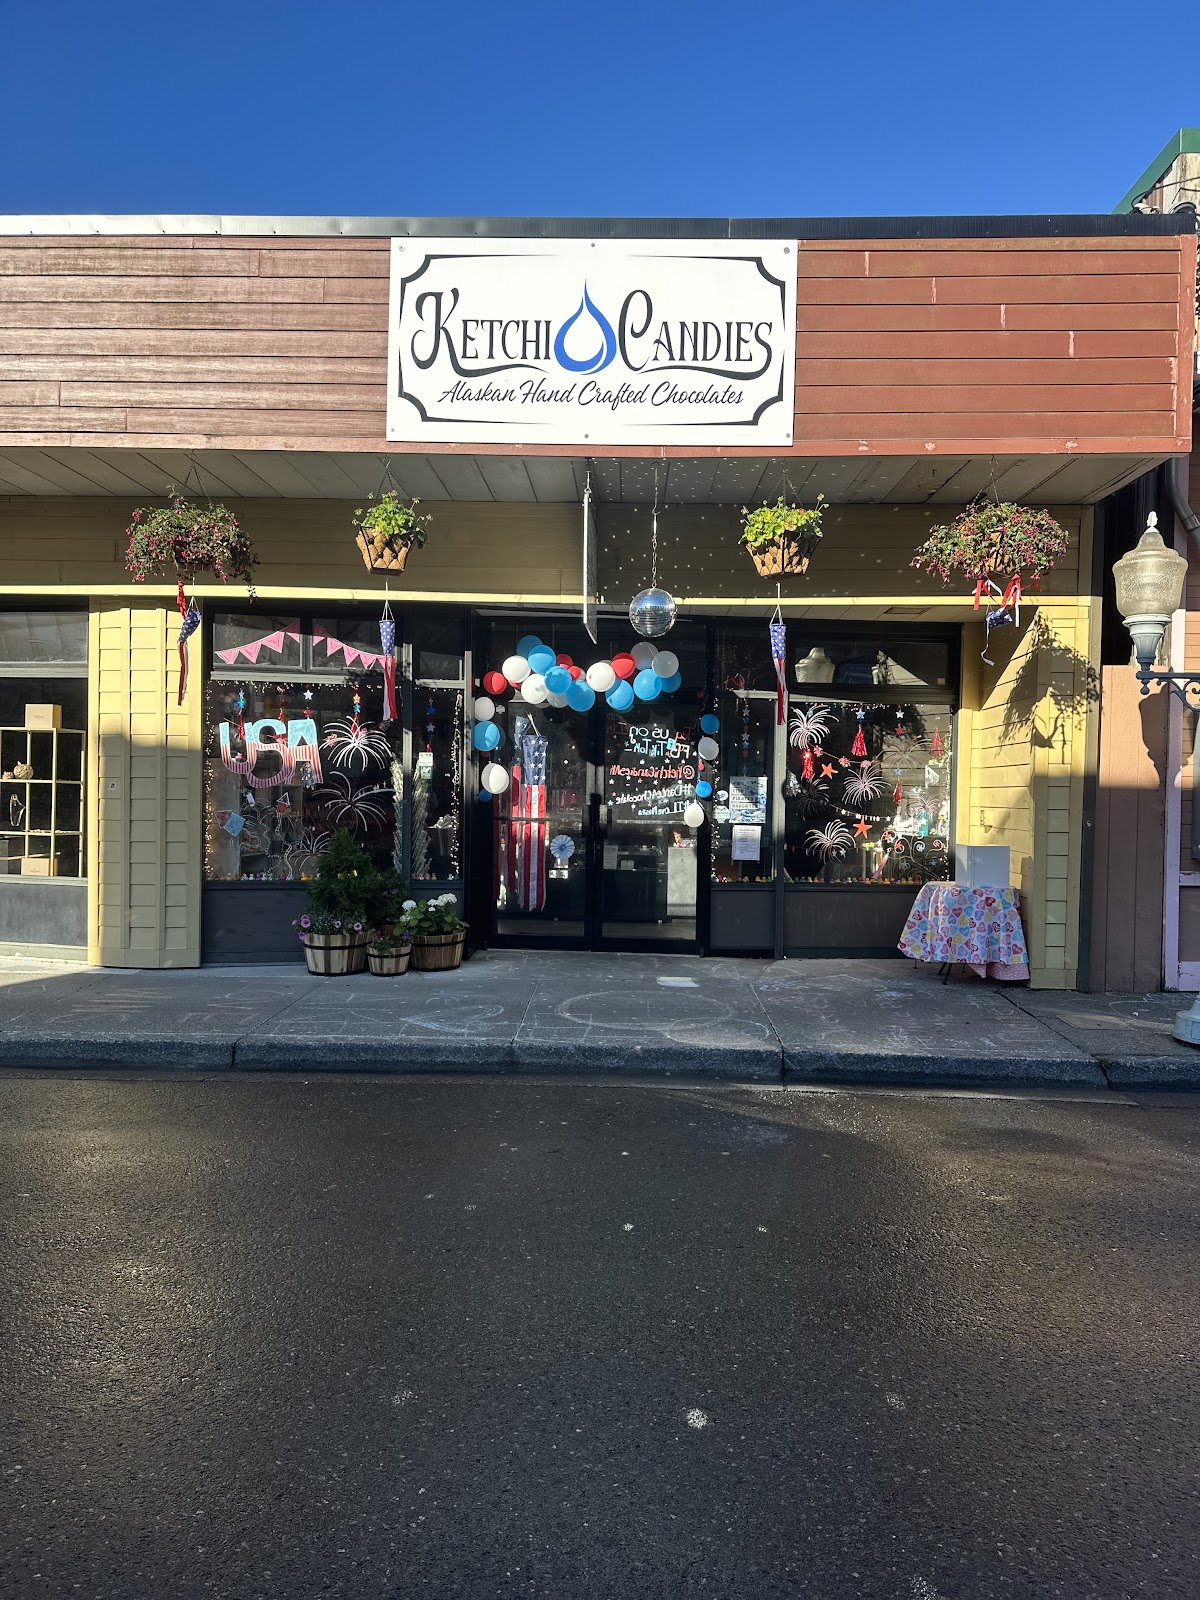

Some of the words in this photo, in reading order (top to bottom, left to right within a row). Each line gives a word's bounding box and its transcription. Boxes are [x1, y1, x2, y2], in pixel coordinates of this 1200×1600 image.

[437, 379, 516, 404] Alaskan
[517, 377, 575, 405] Hand
[578, 380, 648, 411] Crafted
[651, 382, 745, 406] Chocolates
[219, 719, 323, 788] USA
